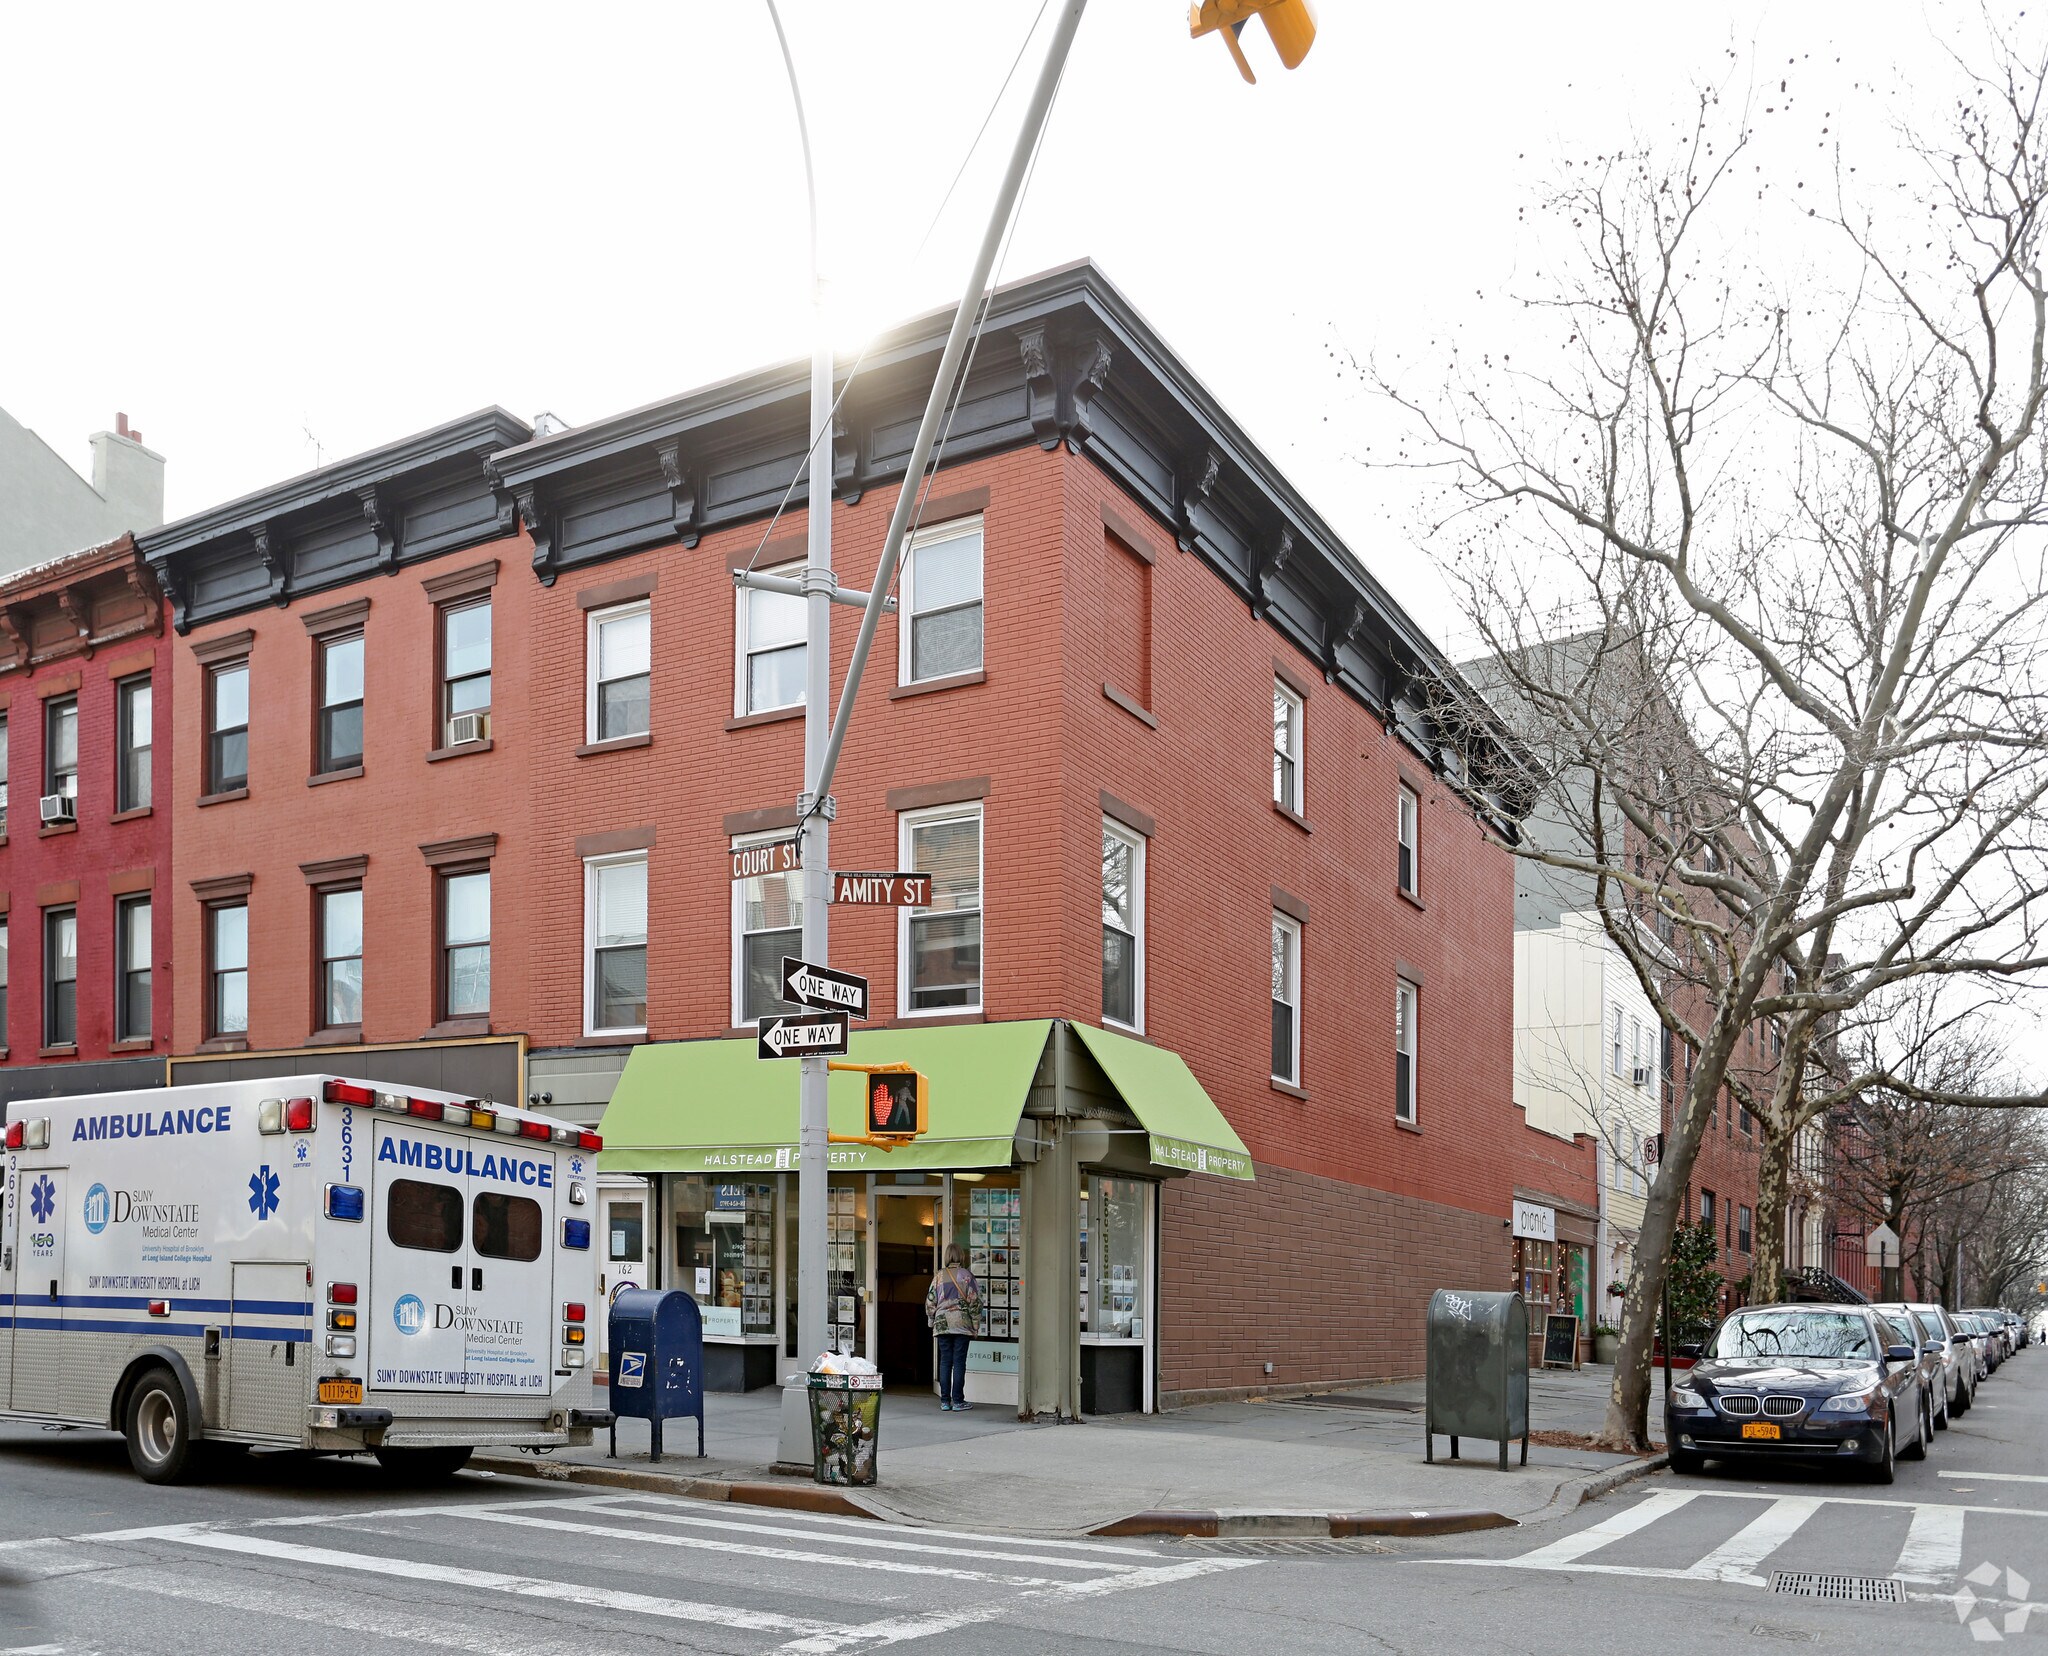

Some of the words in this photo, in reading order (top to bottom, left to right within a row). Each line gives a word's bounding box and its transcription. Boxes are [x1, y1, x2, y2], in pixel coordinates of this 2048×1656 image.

[733, 848, 775, 877] COURT
[783, 843, 800, 869] ST
[839, 878, 895, 903] AMITY
[903, 879, 925, 904] ST
[799, 975, 825, 997] ONE
[831, 983, 857, 1004] WAY
[774, 1028, 800, 1046] ONE
[807, 1026, 835, 1043] WAY
[72, 1106, 231, 1142] AMBULANCE
[341, 1107, 353, 1183] 3631
[378, 1136, 553, 1188] AMBULANCE
[704, 1153, 773, 1166] HALSTEAD
[792, 1151, 867, 1164] PERTY
[1154, 1144, 1197, 1163] HALSTEAD
[1208, 1155, 1246, 1171] PROPERTY
[8, 1155, 17, 1228] 3631
[133, 1190, 154, 1203] SUNY
[112, 1190, 199, 1223] DOWNSTATE
[31, 1233, 54, 1248] 150
[142, 1226, 171, 1238] Medical
[172, 1226, 199, 1238] Center
[163, 1245, 180, 1253] Hospital
[147, 1255, 159, 1263] Long
[174, 1255, 192, 1263] College
[192, 1255, 213, 1263] Hospital
[617, 1264, 633, 1275] 162
[89, 1275, 101, 1288] SUNY
[102, 1275, 129, 1289] DOWNSTATE
[130, 1276, 157, 1290] UNIVERSITY
[157, 1276, 181, 1290] HOSPITAL
[182, 1278, 188, 1290] at
[189, 1277, 201, 1291] LICH
[433, 1303, 523, 1335] DOWNSTATE
[455, 1305, 478, 1316] SUNY
[708, 1317, 739, 1325] PROPERTY
[466, 1333, 496, 1344] Medical
[497, 1335, 523, 1346] Center
[487, 1349, 504, 1357] Hospital
[377, 1369, 397, 1383] SUNY
[399, 1370, 442, 1384] DOWNSTATE
[444, 1371, 485, 1386] UNIVERSITY
[486, 1373, 518, 1387] HOSPITAL
[519, 1376, 527, 1387] at
[528, 1375, 543, 1388] LICH
